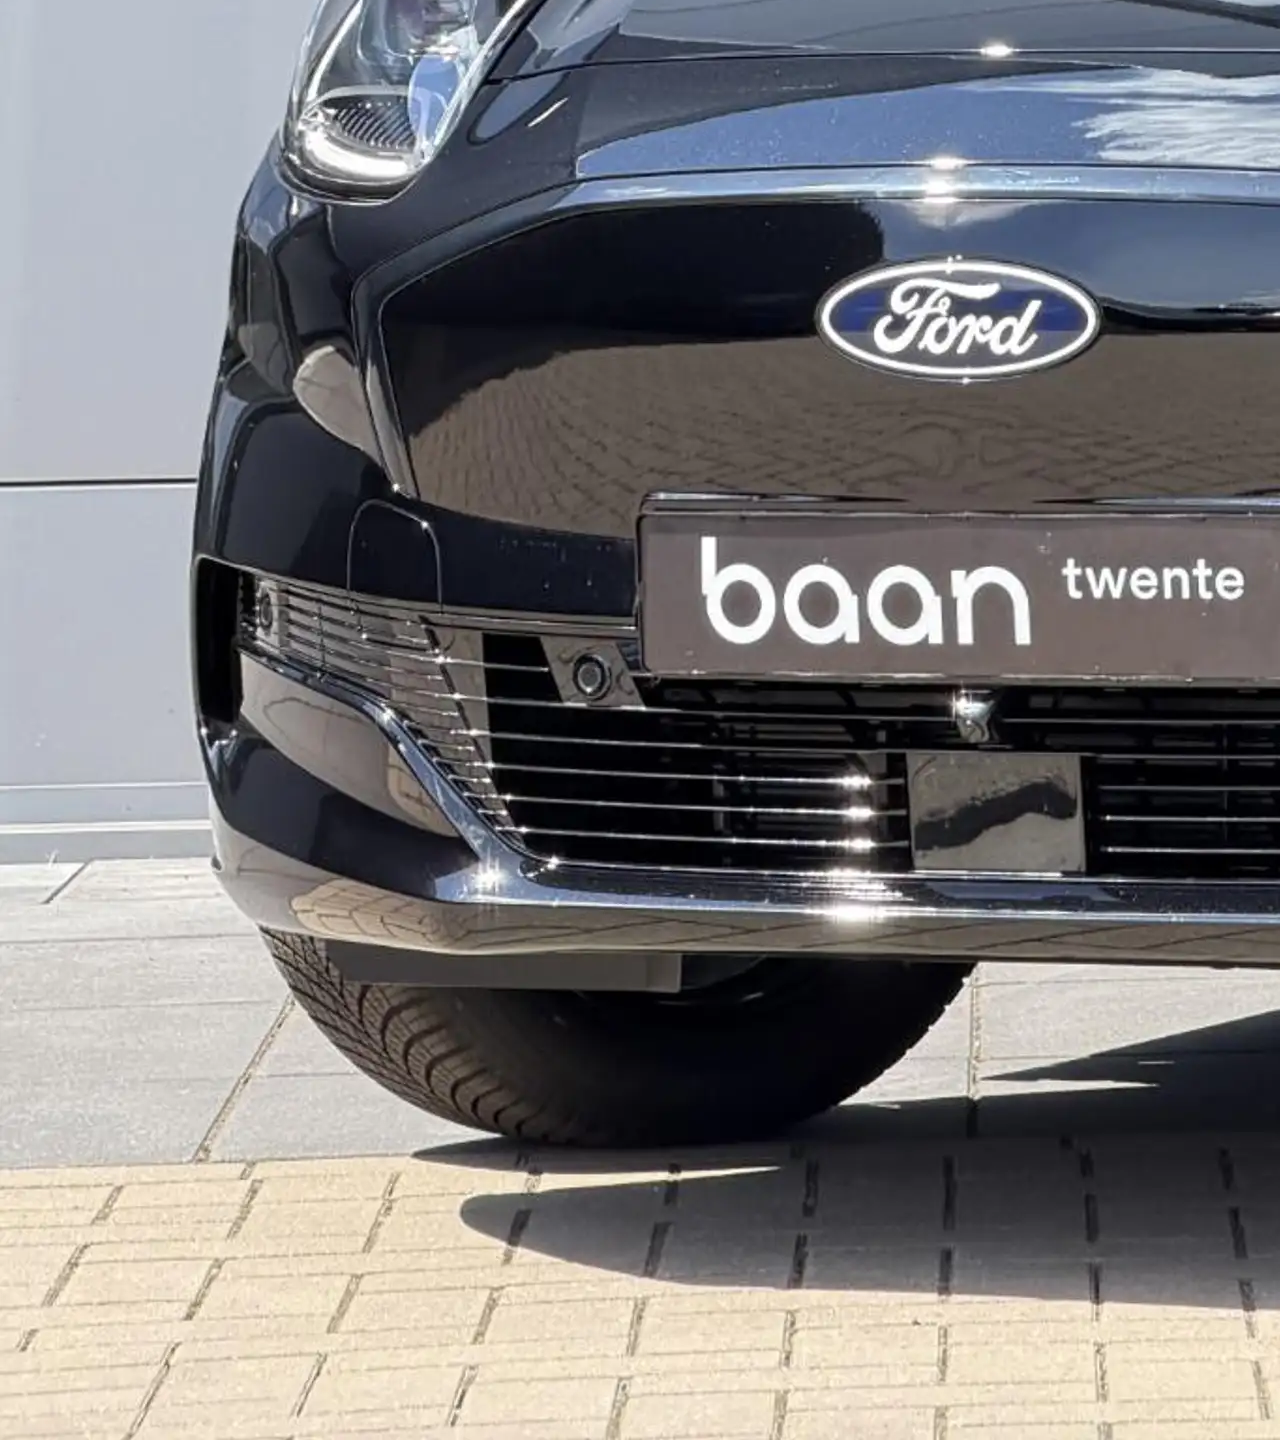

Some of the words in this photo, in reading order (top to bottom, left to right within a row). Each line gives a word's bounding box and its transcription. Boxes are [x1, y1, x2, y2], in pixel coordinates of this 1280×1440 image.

[873, 277, 1042, 356] Ford
[700, 536, 1032, 646] baan
[1061, 557, 1245, 601] twente
